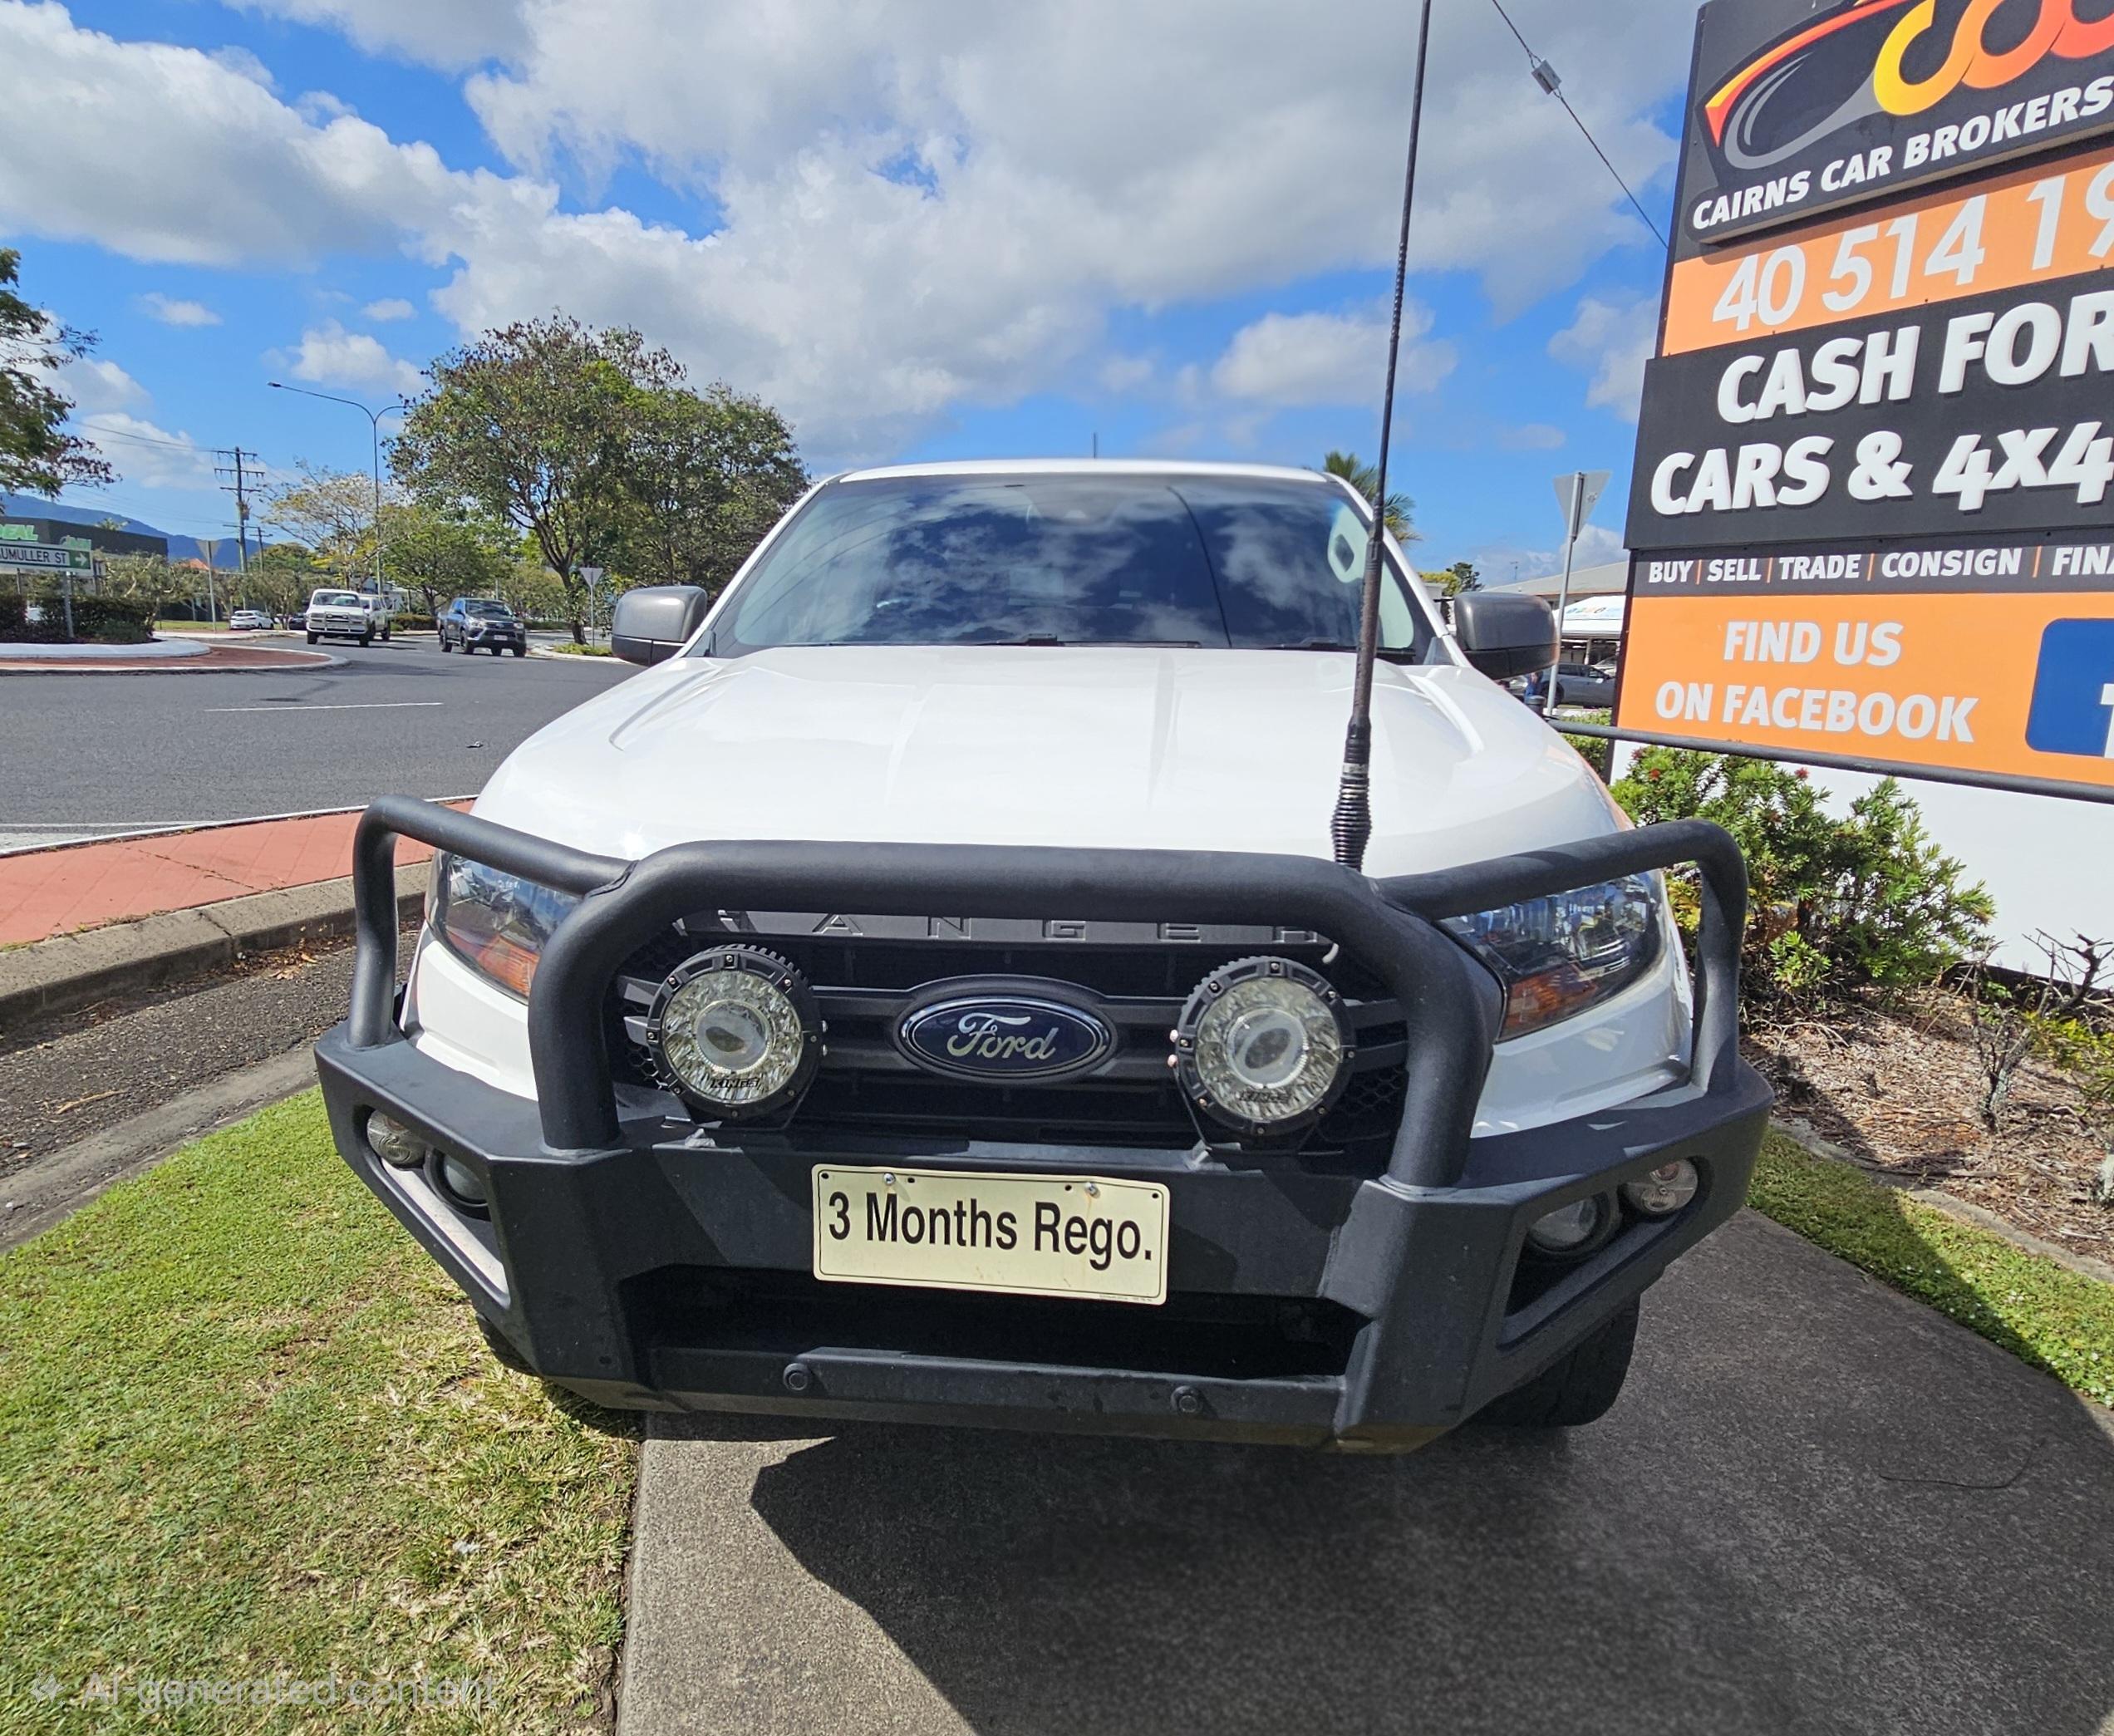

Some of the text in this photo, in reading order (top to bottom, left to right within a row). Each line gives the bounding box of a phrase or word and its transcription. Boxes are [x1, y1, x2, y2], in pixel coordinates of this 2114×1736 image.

[1693, 76, 2114, 229] CAIRNS CAR BROKERS
[1713, 244, 1806, 331] 40
[1822, 194, 1987, 312] 514
[1718, 290, 2114, 423] CASH FOR
[1650, 435, 1835, 515] CARS
[1848, 430, 1913, 500] &
[0, 548, 66, 563] UMULLER ST
[1649, 545, 2114, 583] BUY SELL TRADE CONSIGN FIN
[1723, 621, 1904, 666] FIND US
[1655, 681, 1979, 743] ON FACEBOOK
[946, 1012, 1059, 1060] Ford
[828, 1191, 1152, 1271] 3 Months Rego.
